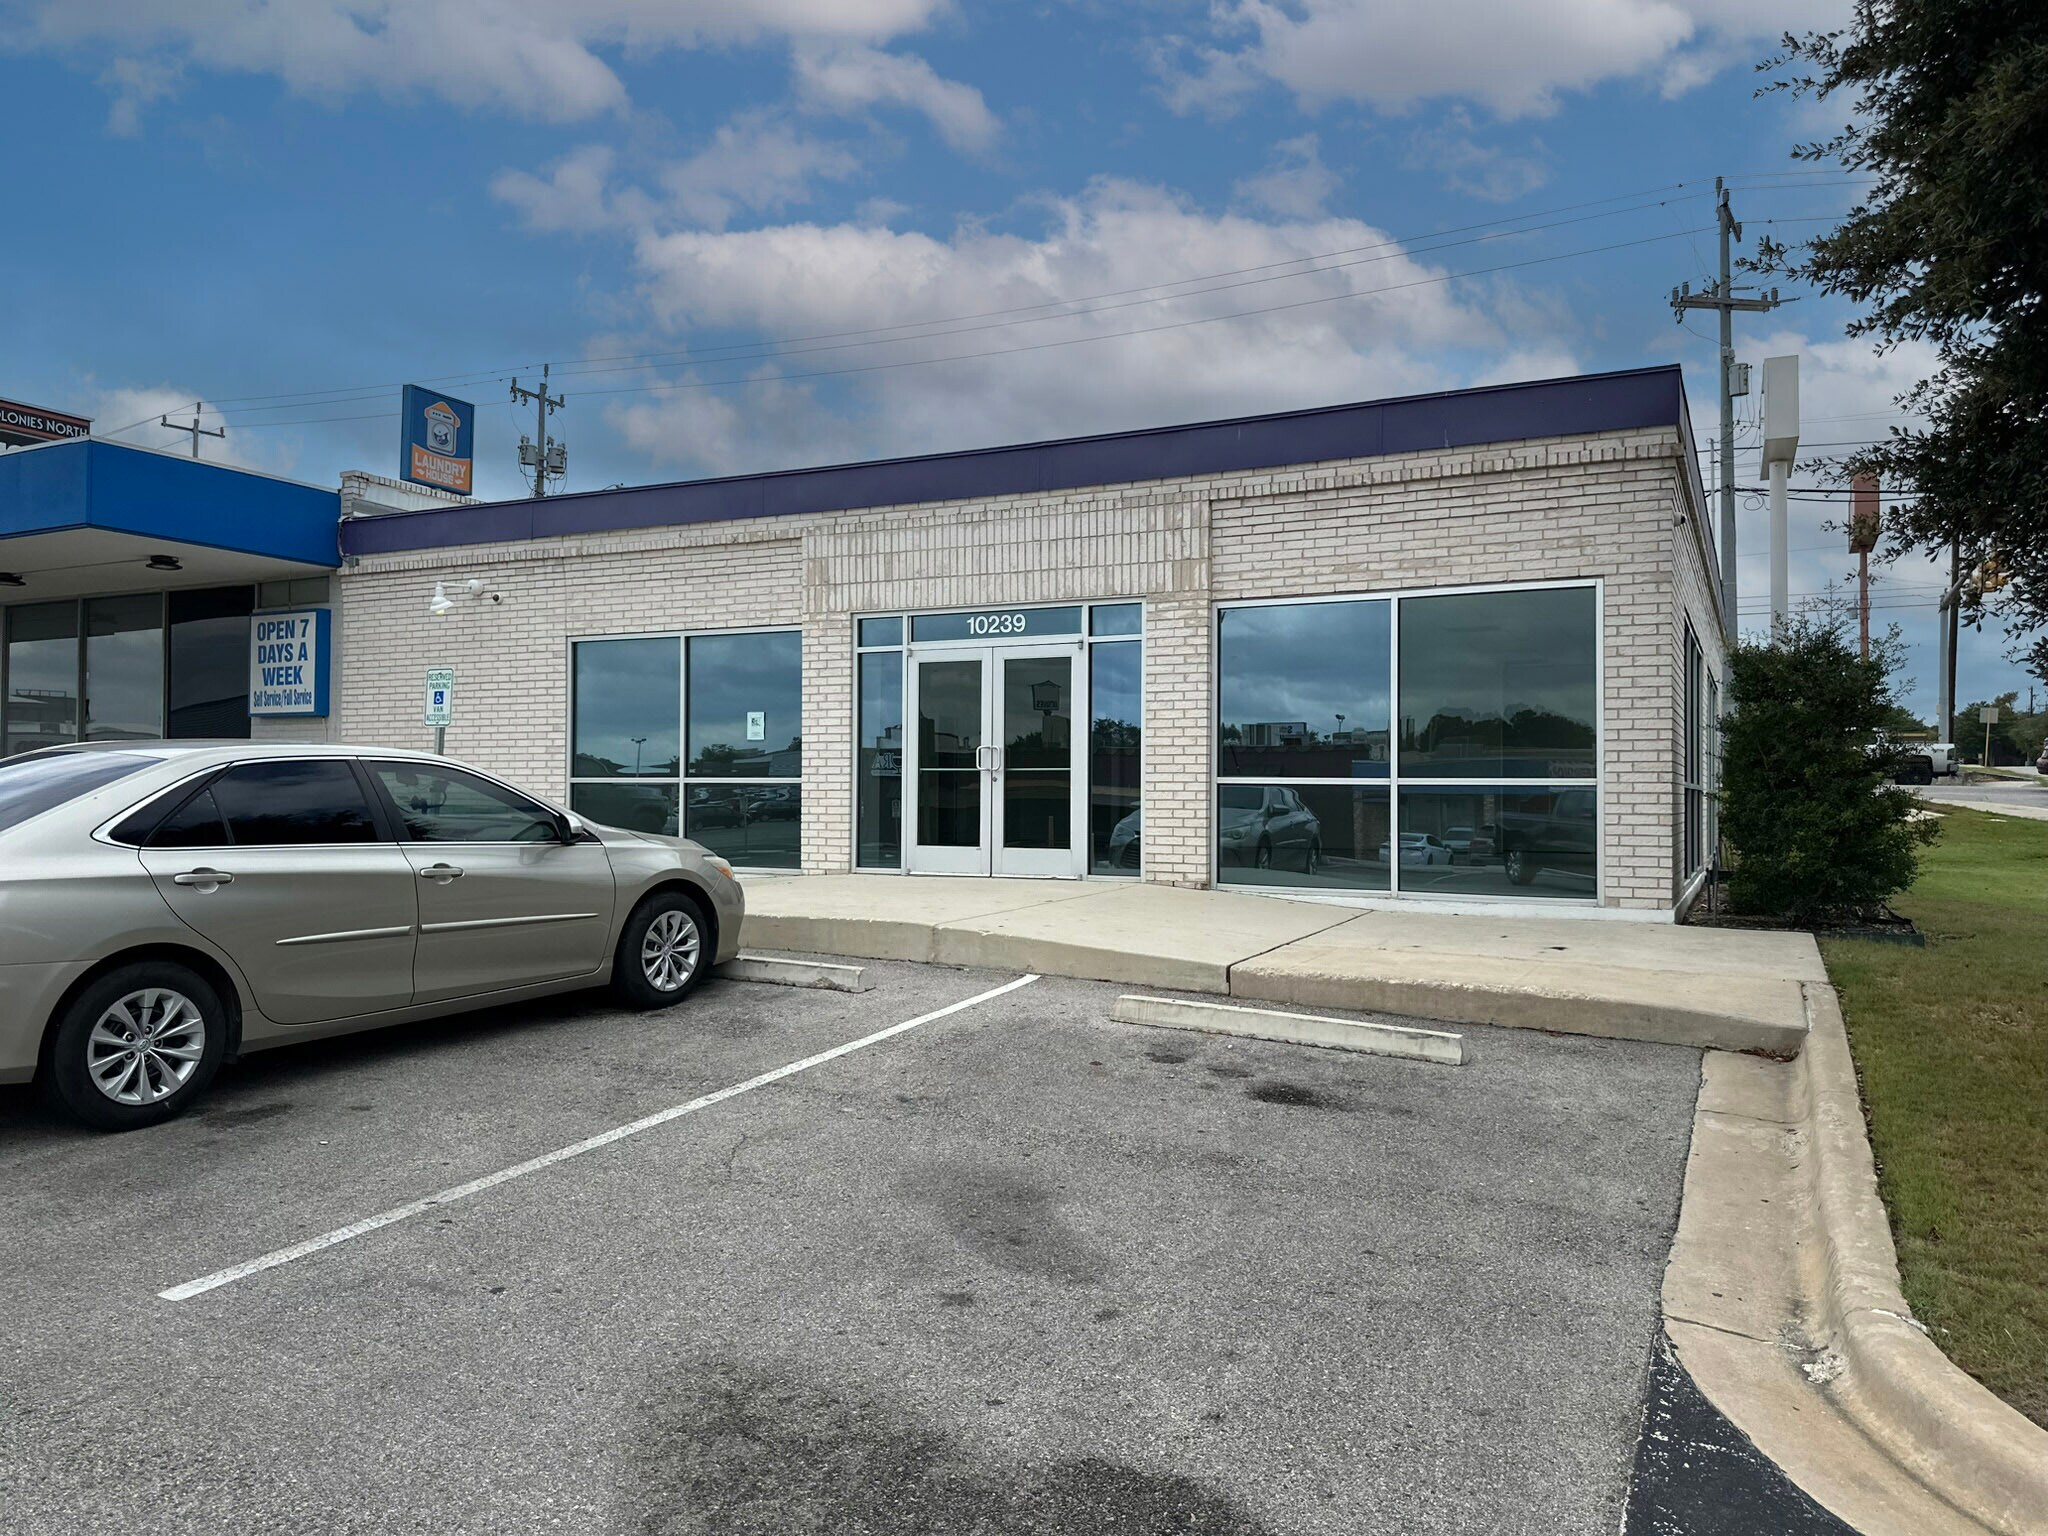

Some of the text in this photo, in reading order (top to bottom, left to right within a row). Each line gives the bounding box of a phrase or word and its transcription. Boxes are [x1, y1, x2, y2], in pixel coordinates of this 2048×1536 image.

[0, 410, 88, 438] LONIES NORTH
[415, 452, 466, 478] LAUNDRY
[426, 469, 454, 485] HOUSE
[257, 618, 310, 642] OPEN 7
[966, 613, 1026, 635] 10239
[257, 641, 308, 664] DAYS A
[262, 665, 303, 687] WEEK
[429, 673, 451, 681] RESERVED
[429, 682, 450, 690] PARKING
[293, 688, 312, 706] Service
